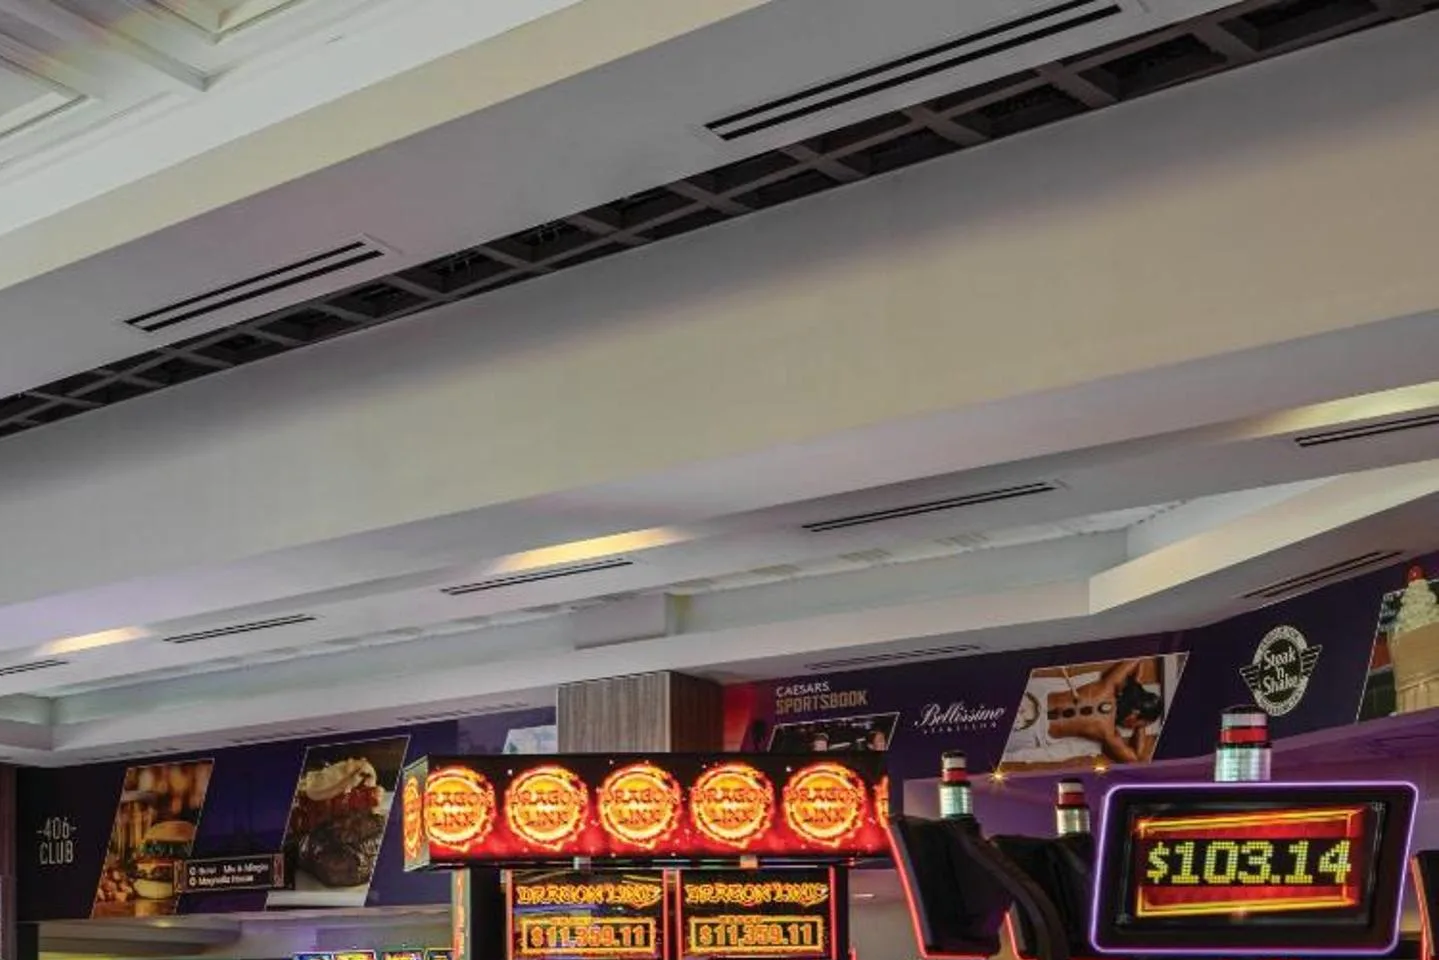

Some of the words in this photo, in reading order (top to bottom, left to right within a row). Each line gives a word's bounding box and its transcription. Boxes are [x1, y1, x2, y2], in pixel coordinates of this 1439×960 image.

[1264, 645, 1297, 670] Steak
[776, 681, 831, 697] CAESARS
[1263, 673, 1300, 696] Shake
[776, 690, 869, 715] SPORTSBOOK
[40, 840, 74, 865] CLUB
[1146, 840, 1351, 884] $103.14
[516, 885, 603, 905] DRAGON
[684, 884, 773, 904] DRAGON
